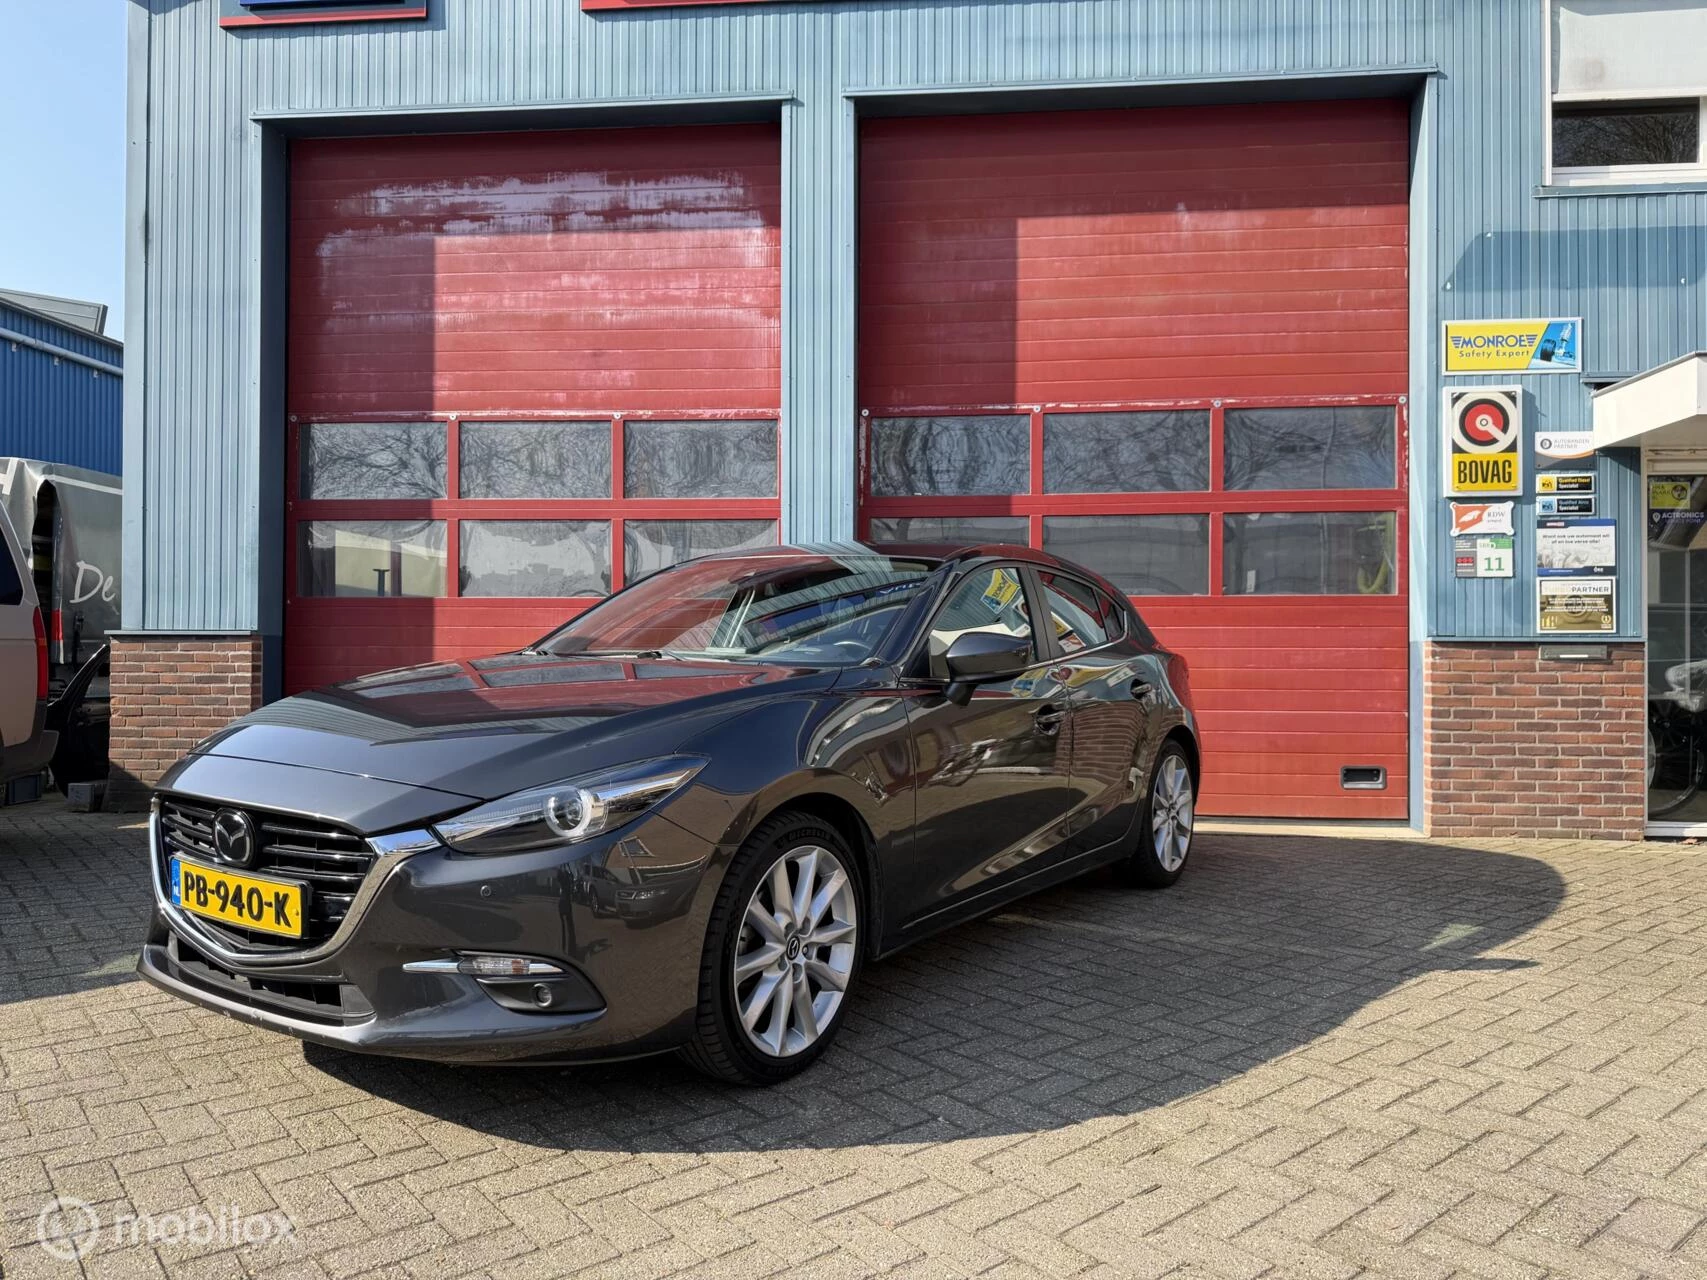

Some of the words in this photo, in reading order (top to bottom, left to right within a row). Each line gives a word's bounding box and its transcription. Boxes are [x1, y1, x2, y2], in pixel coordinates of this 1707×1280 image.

[1461, 334, 1528, 349] MONROE
[1459, 350, 1492, 359] Safety
[1496, 350, 1530, 358] Expert
[1457, 459, 1512, 484] BOVAG
[1484, 557, 1505, 571] 11
[69, 560, 116, 604] De
[184, 870, 293, 929] PB-940-K
